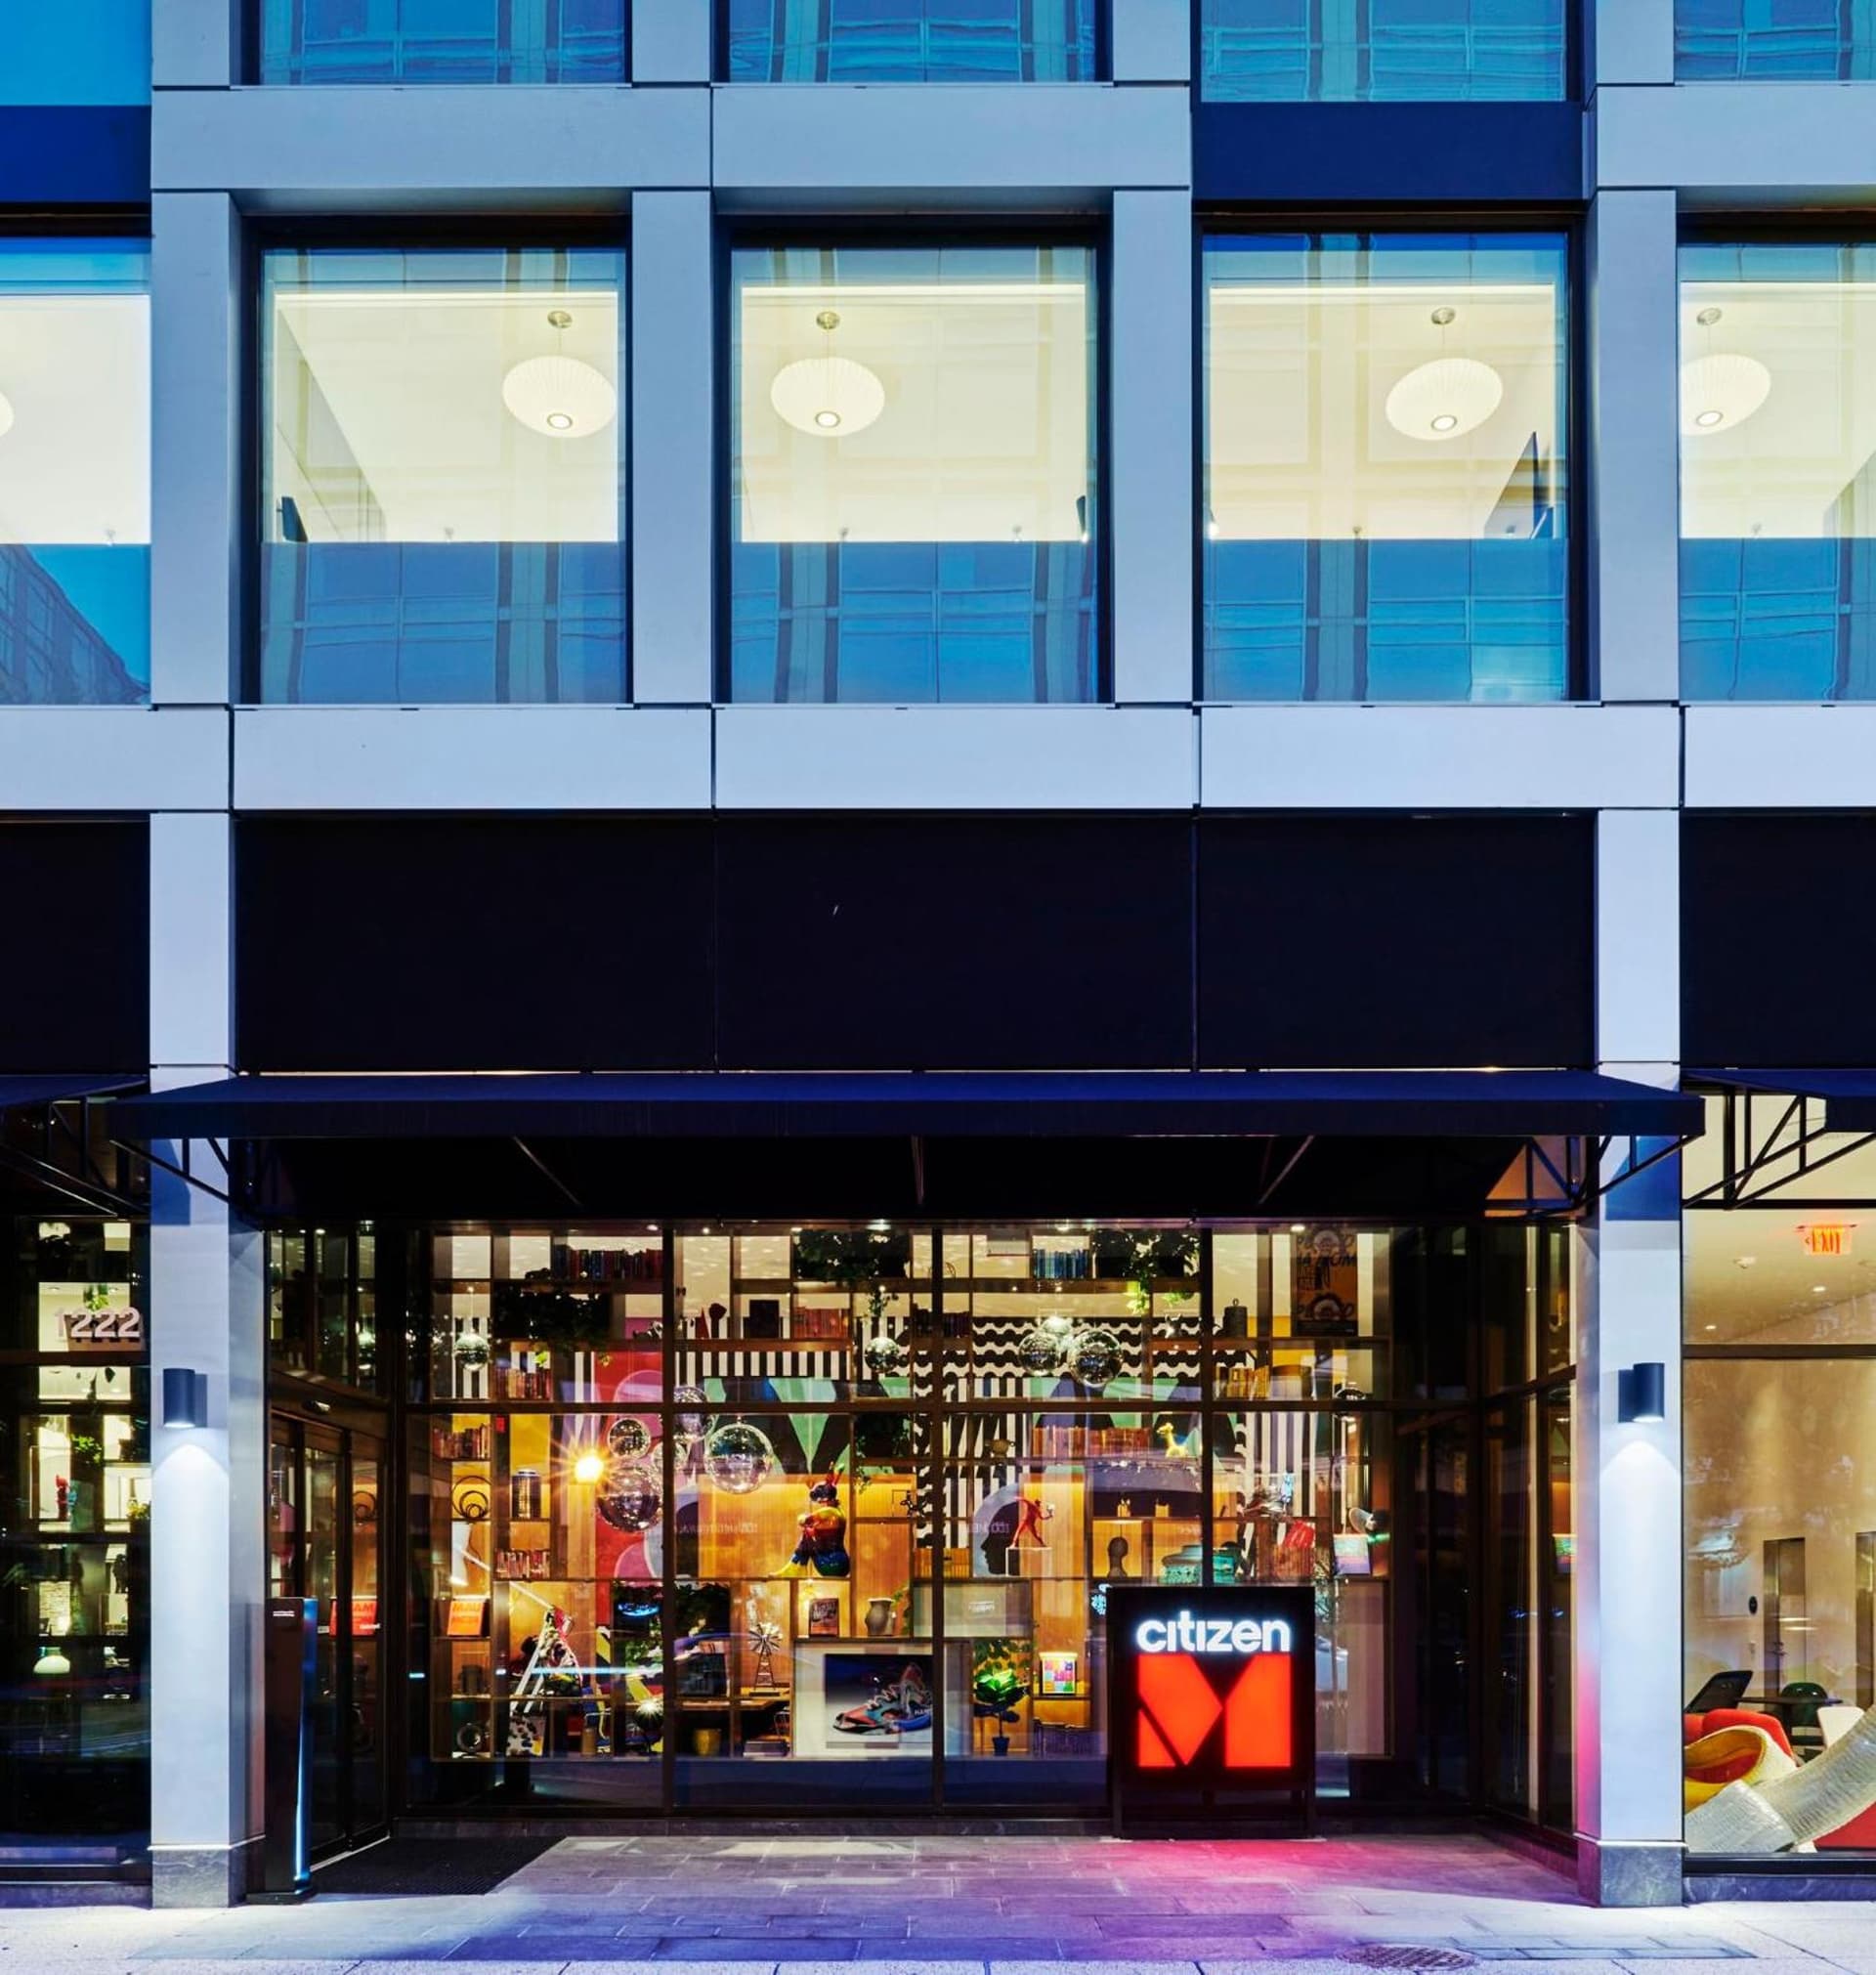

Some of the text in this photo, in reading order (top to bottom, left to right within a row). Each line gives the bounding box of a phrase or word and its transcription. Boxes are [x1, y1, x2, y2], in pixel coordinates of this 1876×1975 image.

[1812, 1227, 1841, 1254] EXIT
[55, 1307, 140, 1338] 1222
[1136, 1610, 1291, 1653] citizen
[1138, 1653, 1291, 1768] M
